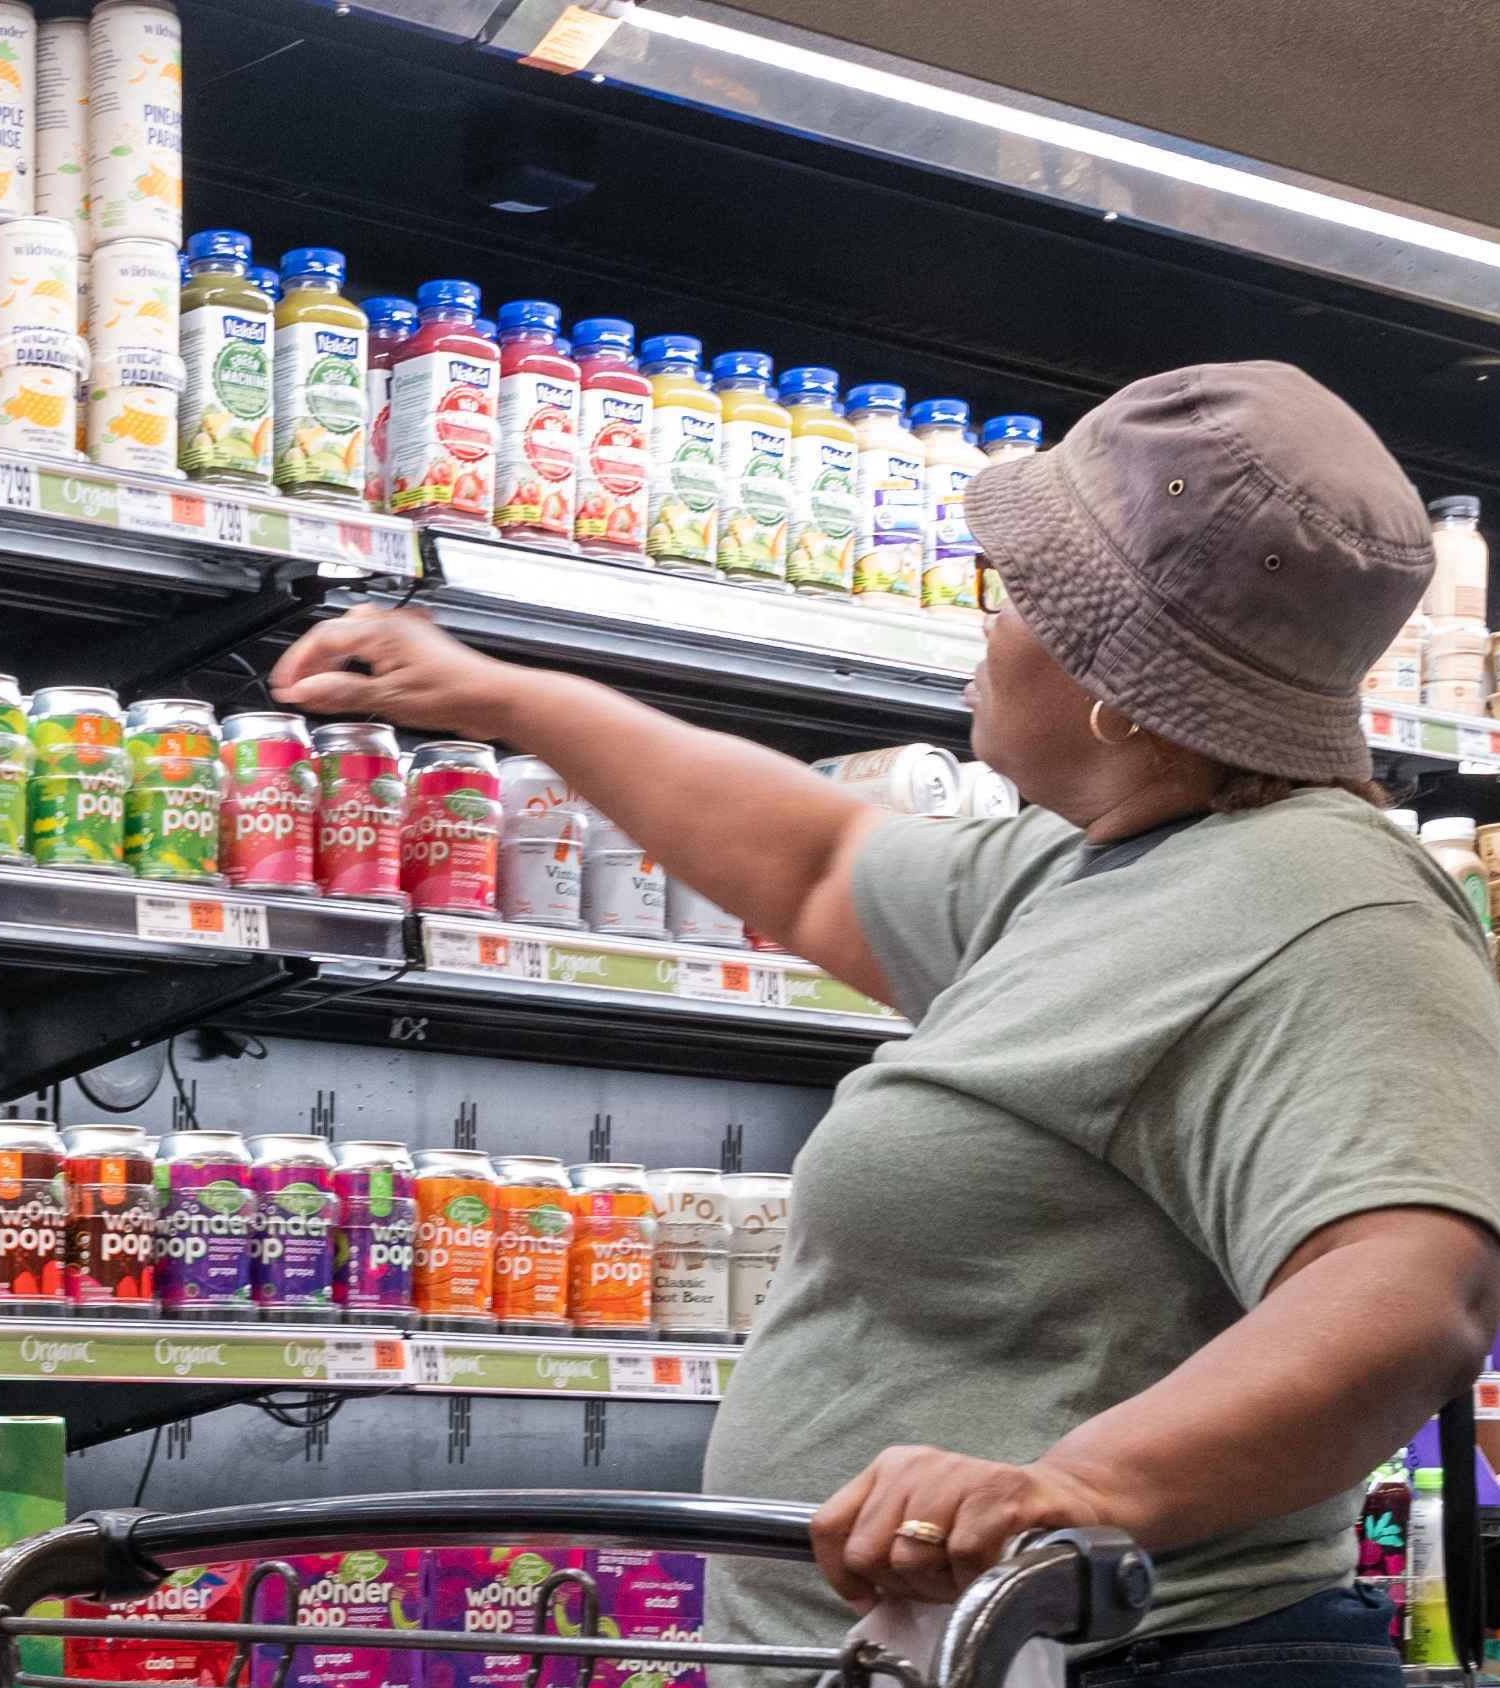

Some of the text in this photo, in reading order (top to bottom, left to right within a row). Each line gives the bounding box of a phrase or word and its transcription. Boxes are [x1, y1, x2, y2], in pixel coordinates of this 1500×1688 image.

[77, 792, 122, 822] pop
[162, 806, 216, 836] pop
[236, 809, 294, 840] pop
[320, 822, 377, 851] pop
[370, 1244, 411, 1270] pop
[208, 1267, 238, 1278] grape
[284, 1268, 314, 1279] grape
[592, 1261, 642, 1286] pop
[681, 1292, 714, 1305] Beer
[20, 1334, 96, 1372] Organic
[20, 1335, 96, 1374] Organic
[155, 1338, 226, 1375] Organic
[537, 1353, 598, 1388] Organic
[145, 1656, 175, 1671] cola
[314, 1651, 352, 1669] grape
[484, 1653, 521, 1670] grape
